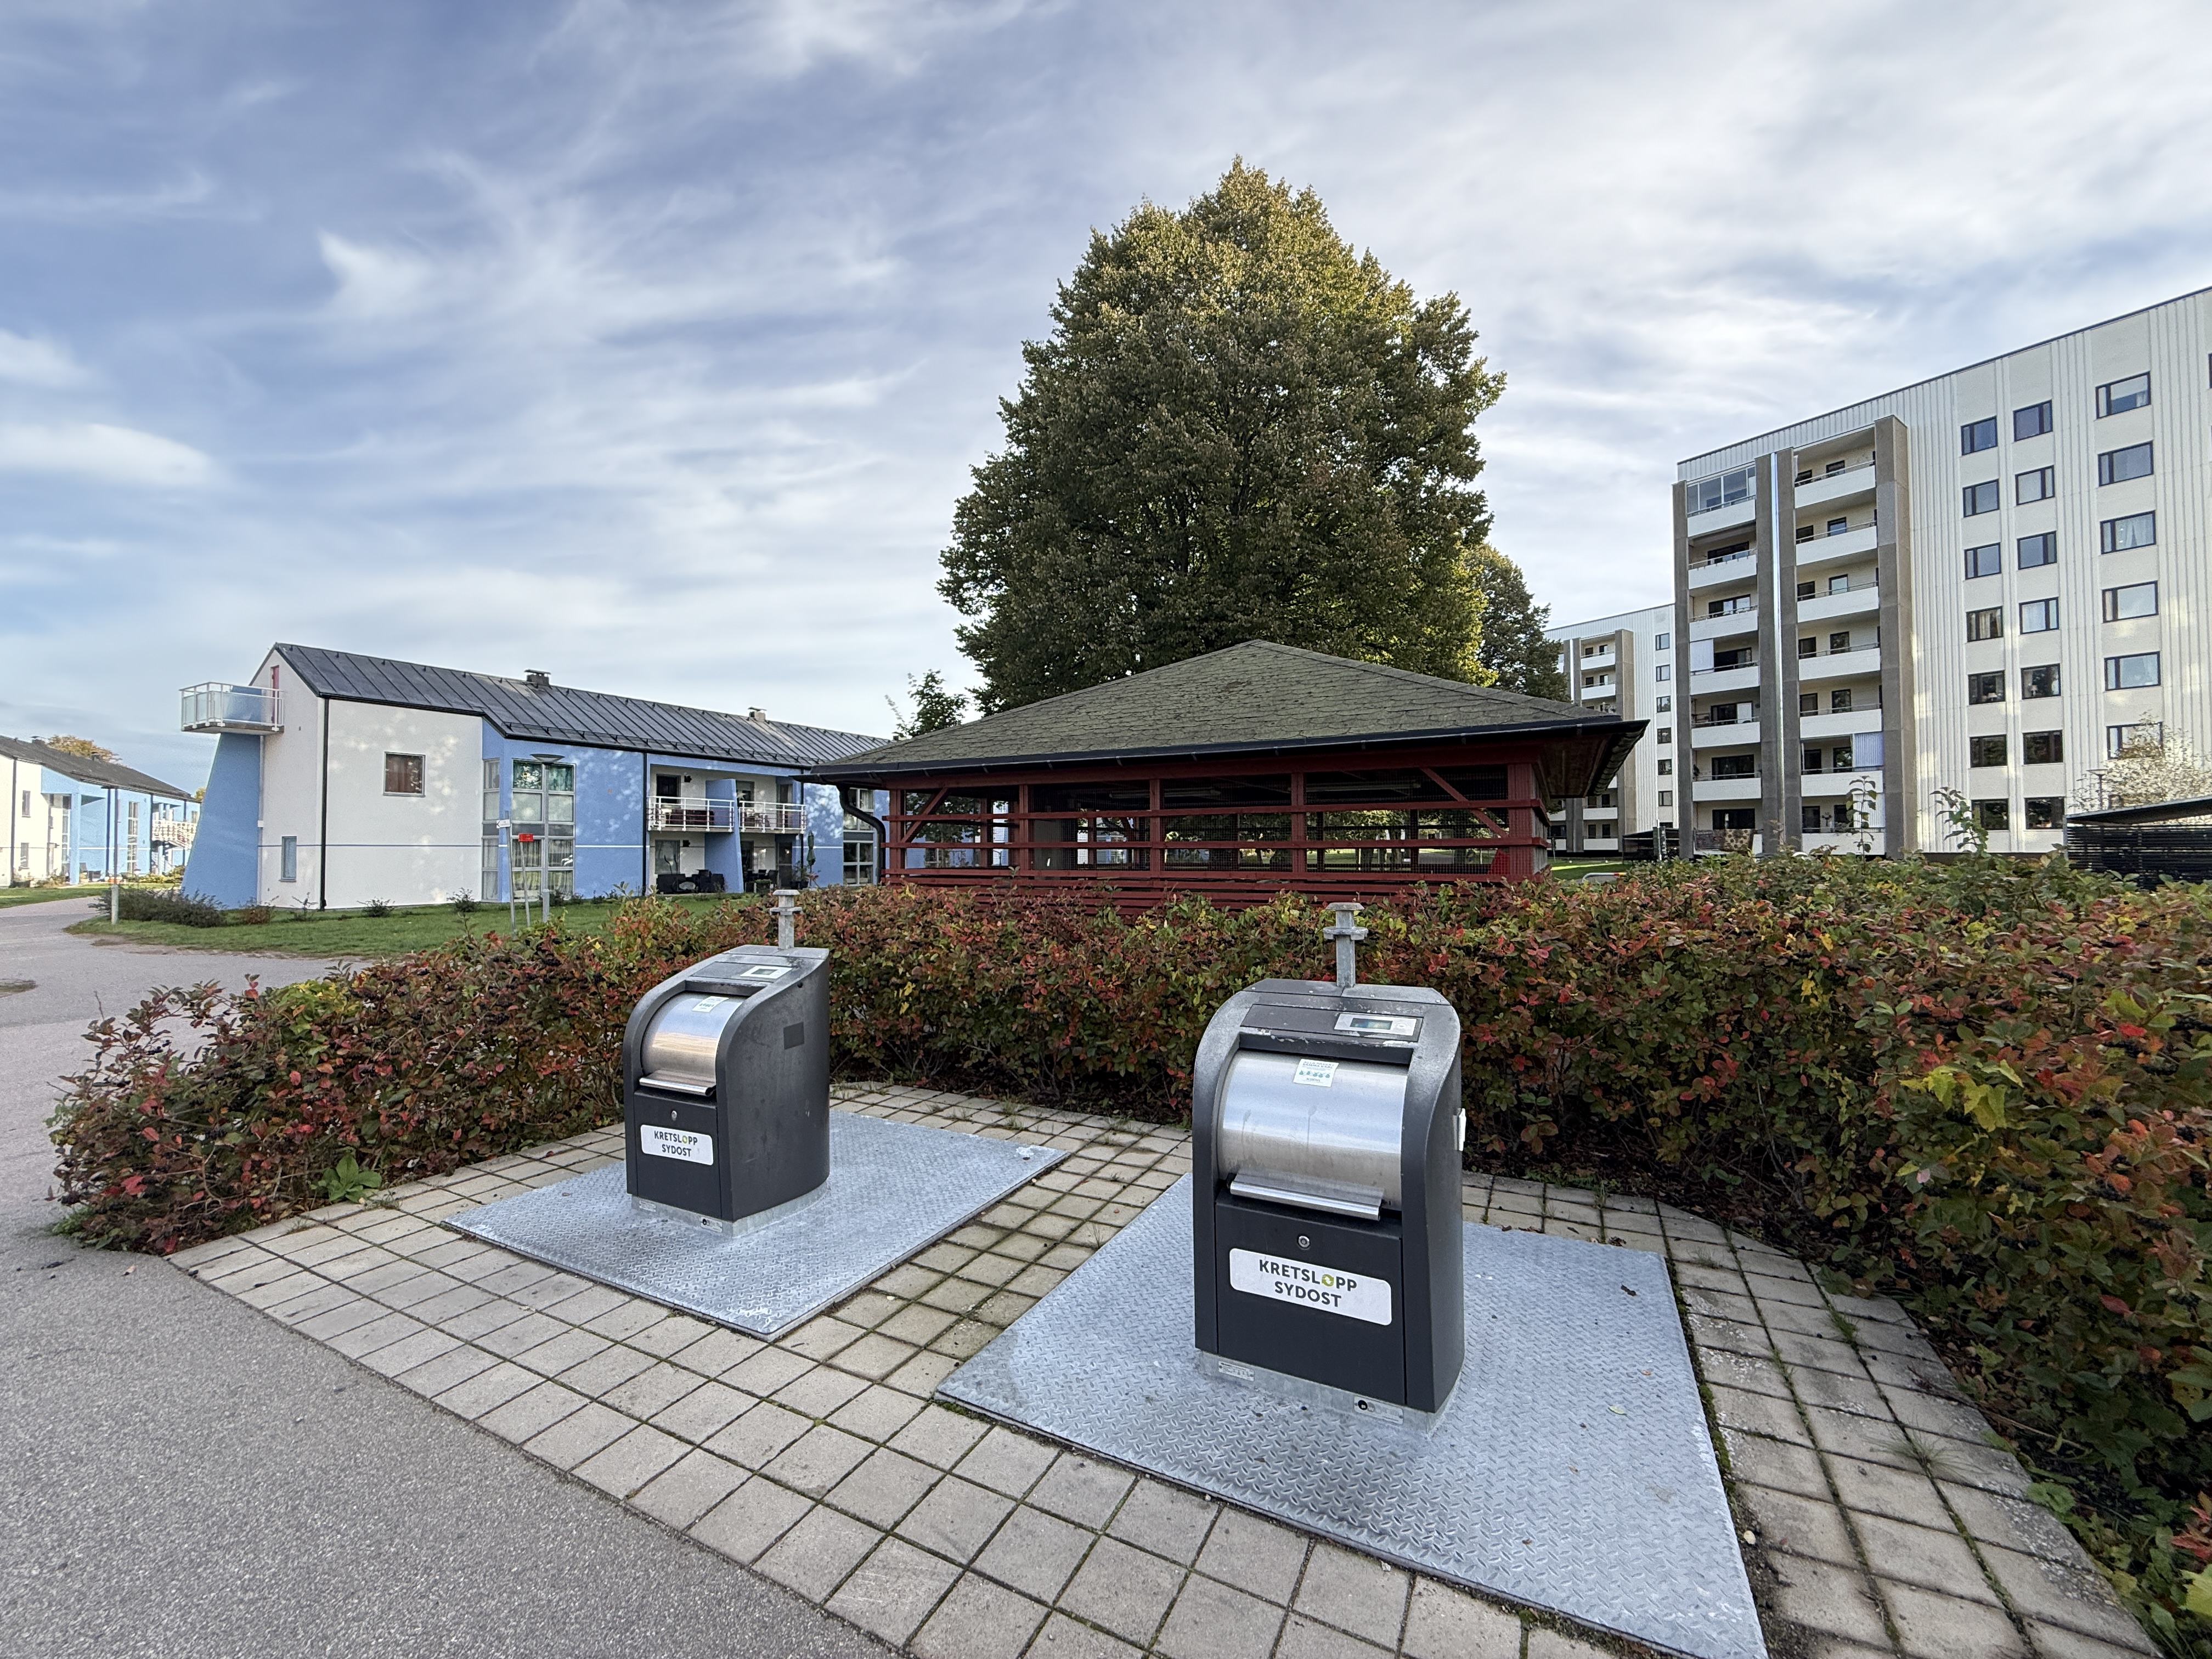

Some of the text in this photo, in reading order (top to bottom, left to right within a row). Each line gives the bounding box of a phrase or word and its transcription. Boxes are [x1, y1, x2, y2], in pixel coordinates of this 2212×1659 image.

[654, 1130, 698, 1146] KRETSLOPP
[662, 1144, 692, 1157] SYDOST
[1259, 1259, 1357, 1291] KRETSLOPP
[1274, 1281, 1342, 1307] SYDOST
